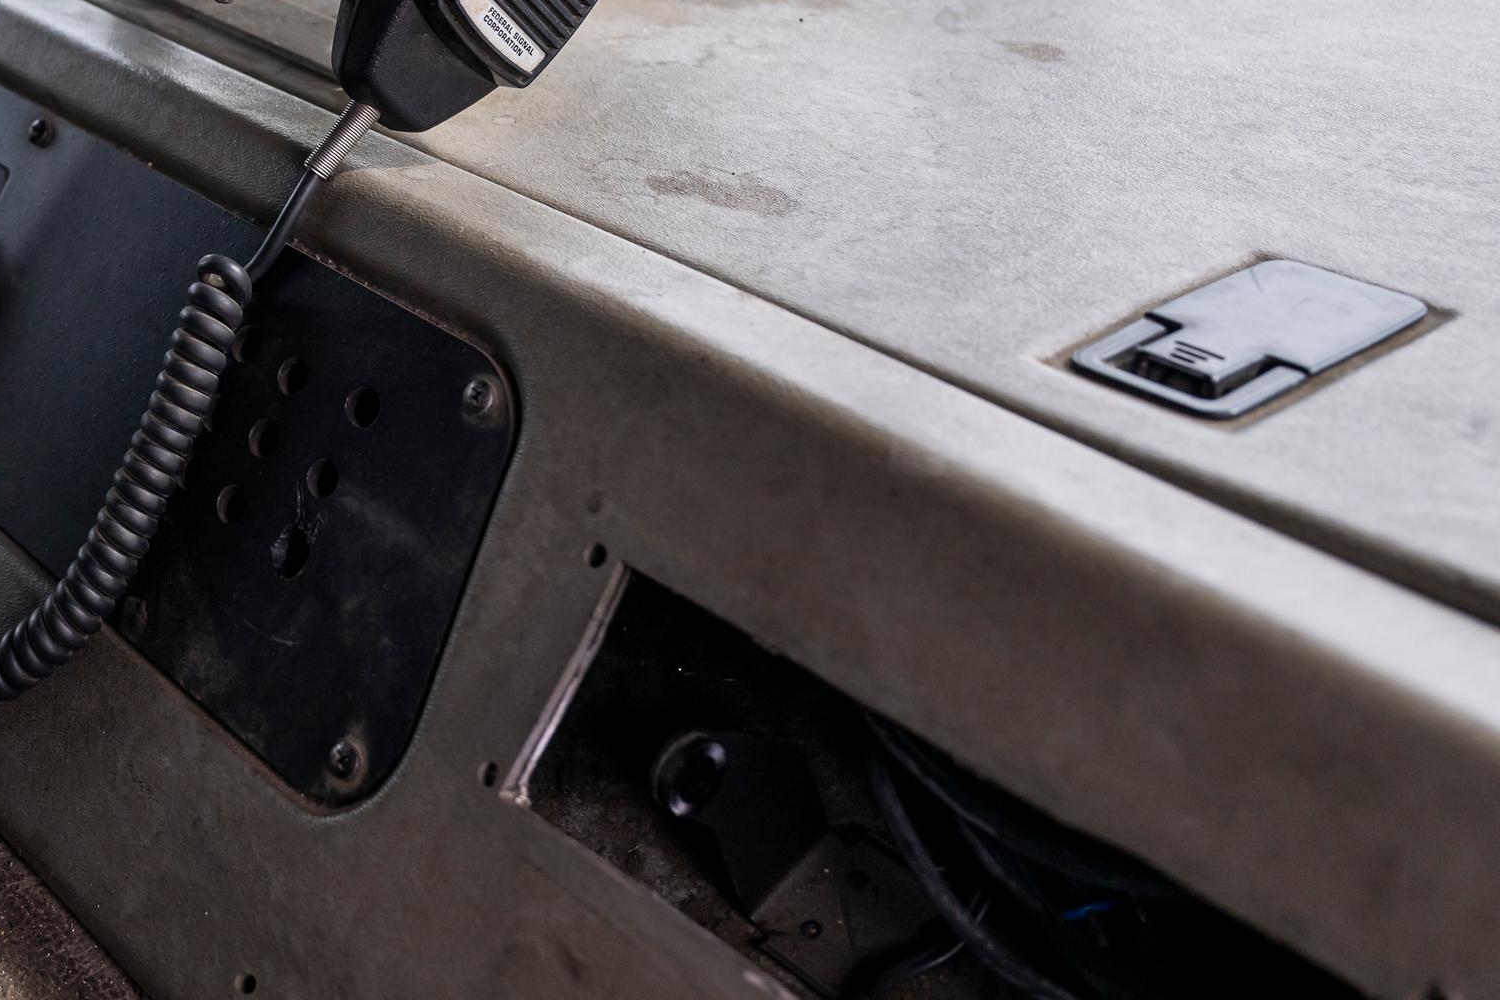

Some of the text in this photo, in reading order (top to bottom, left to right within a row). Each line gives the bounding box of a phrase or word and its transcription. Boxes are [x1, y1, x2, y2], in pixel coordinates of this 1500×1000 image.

[483, 15, 523, 56] CORPORATION
[488, 6, 534, 56] FEDERAL SIGNAL
